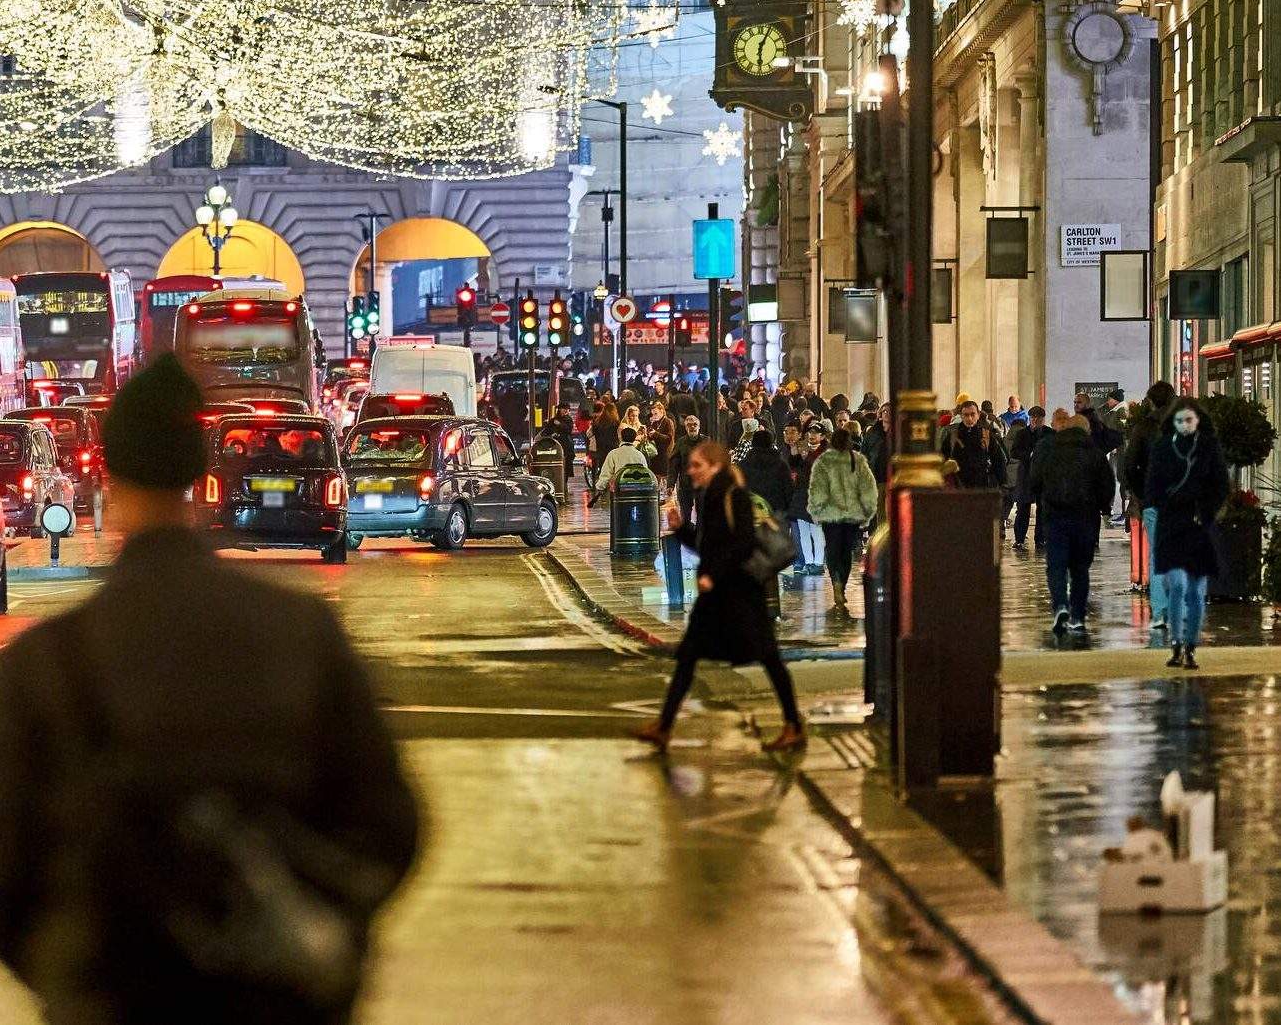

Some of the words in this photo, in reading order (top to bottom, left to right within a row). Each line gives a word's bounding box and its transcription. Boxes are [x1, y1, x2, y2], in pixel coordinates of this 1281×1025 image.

[1066, 228, 1101, 236] CARLTON
[1066, 237, 1096, 246] STREET
[1099, 237, 1116, 245] SW1
